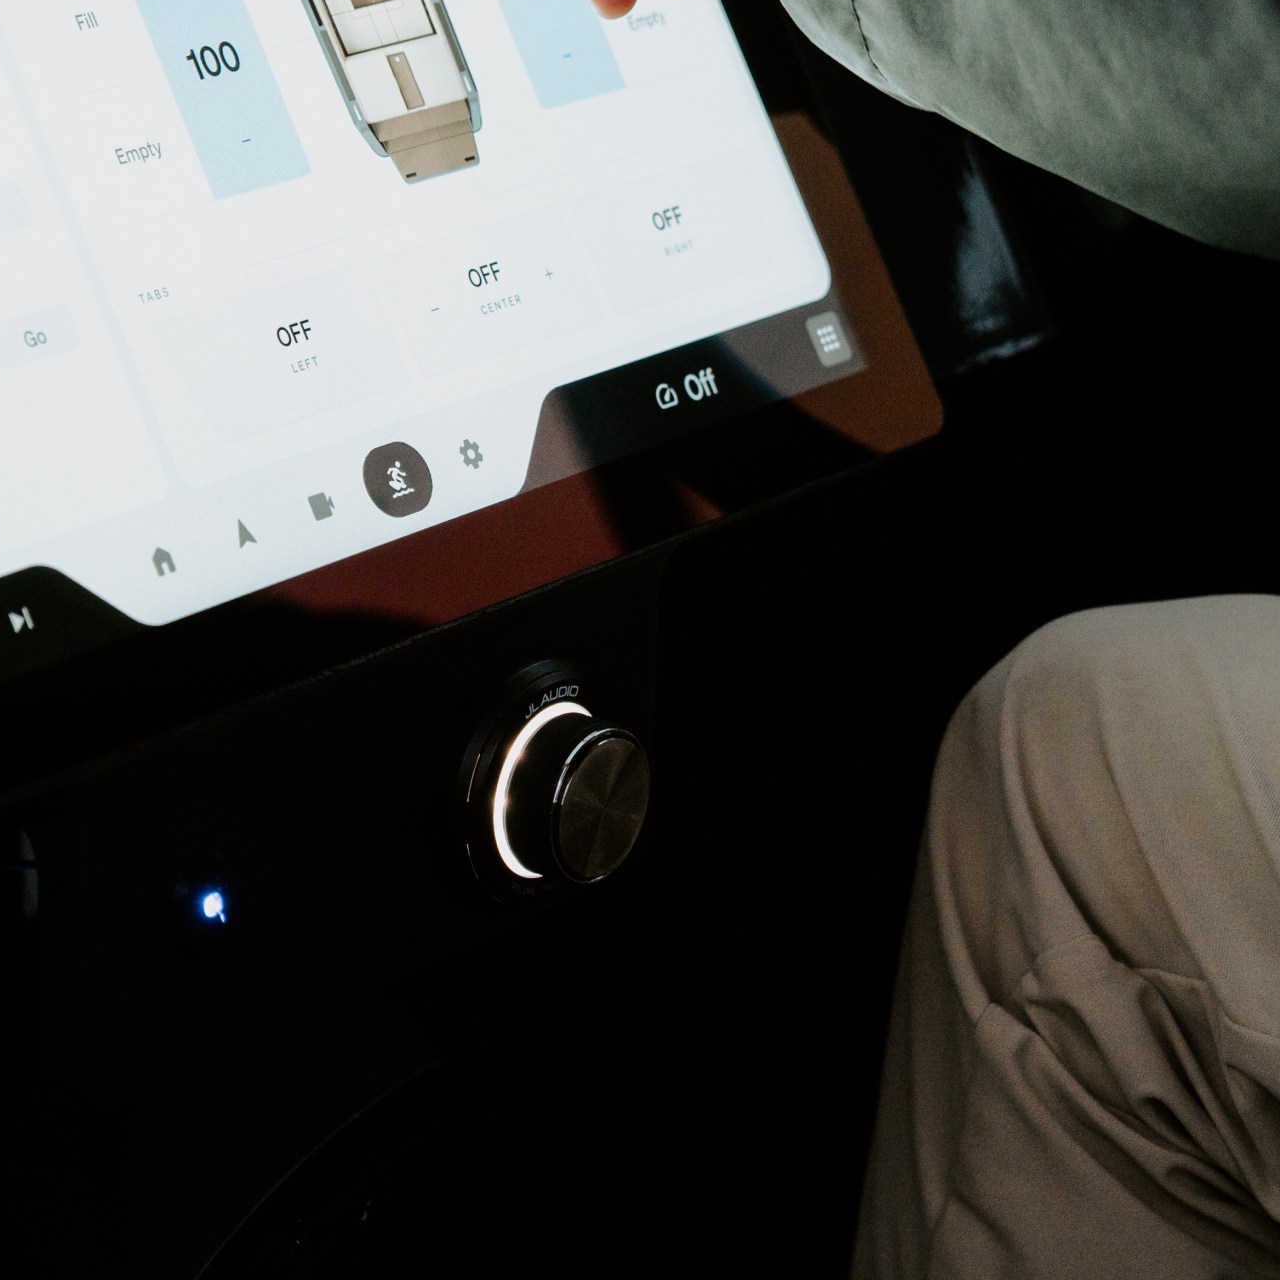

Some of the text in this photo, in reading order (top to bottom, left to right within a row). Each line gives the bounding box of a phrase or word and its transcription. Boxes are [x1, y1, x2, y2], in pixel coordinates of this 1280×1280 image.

[74, 11, 100, 31] Fill
[185, 40, 241, 80] 100
[114, 140, 162, 166] Empty
[651, 205, 682, 231] OFF
[467, 261, 500, 288] OFF
[137, 286, 170, 304] TABS
[480, 293, 522, 316] CENTER
[23, 329, 48, 348] Go
[276, 318, 312, 348] OFF
[290, 355, 318, 374] LEFT
[684, 367, 719, 404] Off
[525, 684, 579, 719] JL AUDIO
